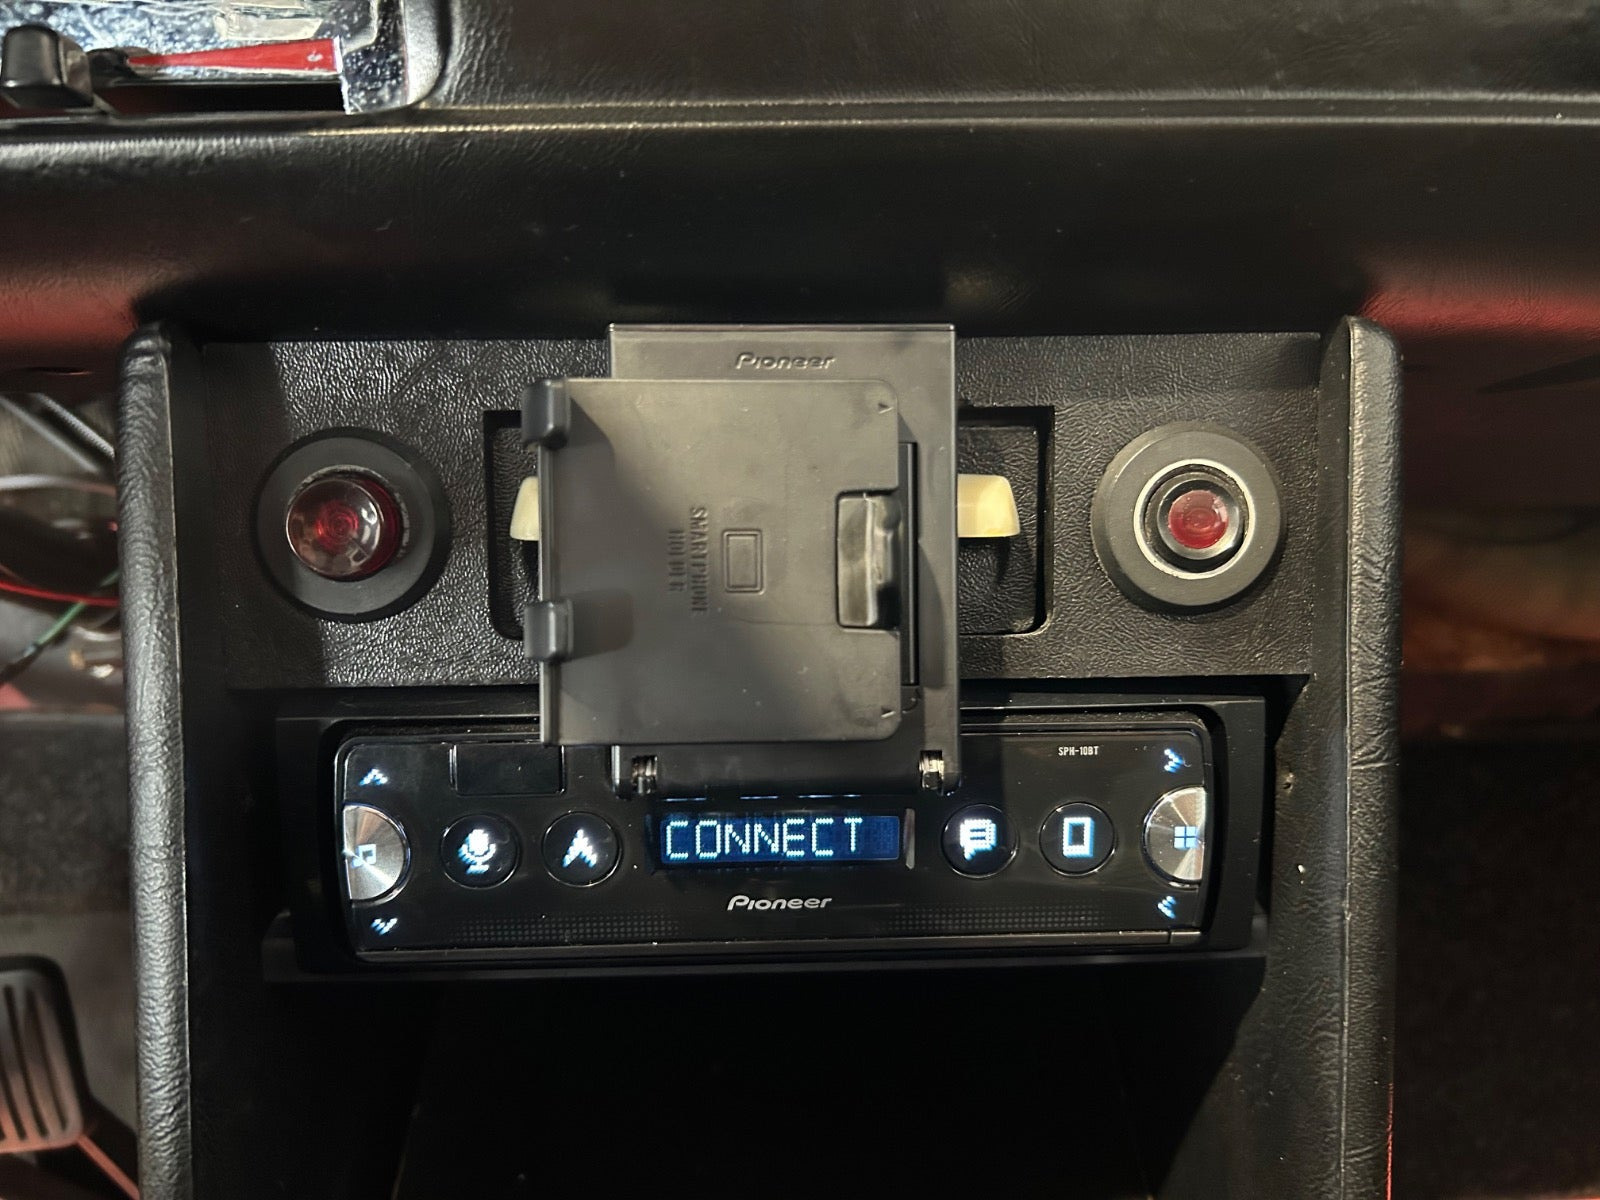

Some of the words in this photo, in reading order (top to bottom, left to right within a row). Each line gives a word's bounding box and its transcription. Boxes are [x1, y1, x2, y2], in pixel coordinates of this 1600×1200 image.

[736, 351, 835, 370] Pioneer
[690, 506, 708, 613] SMARTPHONE
[1058, 745, 1099, 756] SPH-10BT
[665, 817, 863, 860] CONNECT
[727, 894, 833, 911] Pioneer
